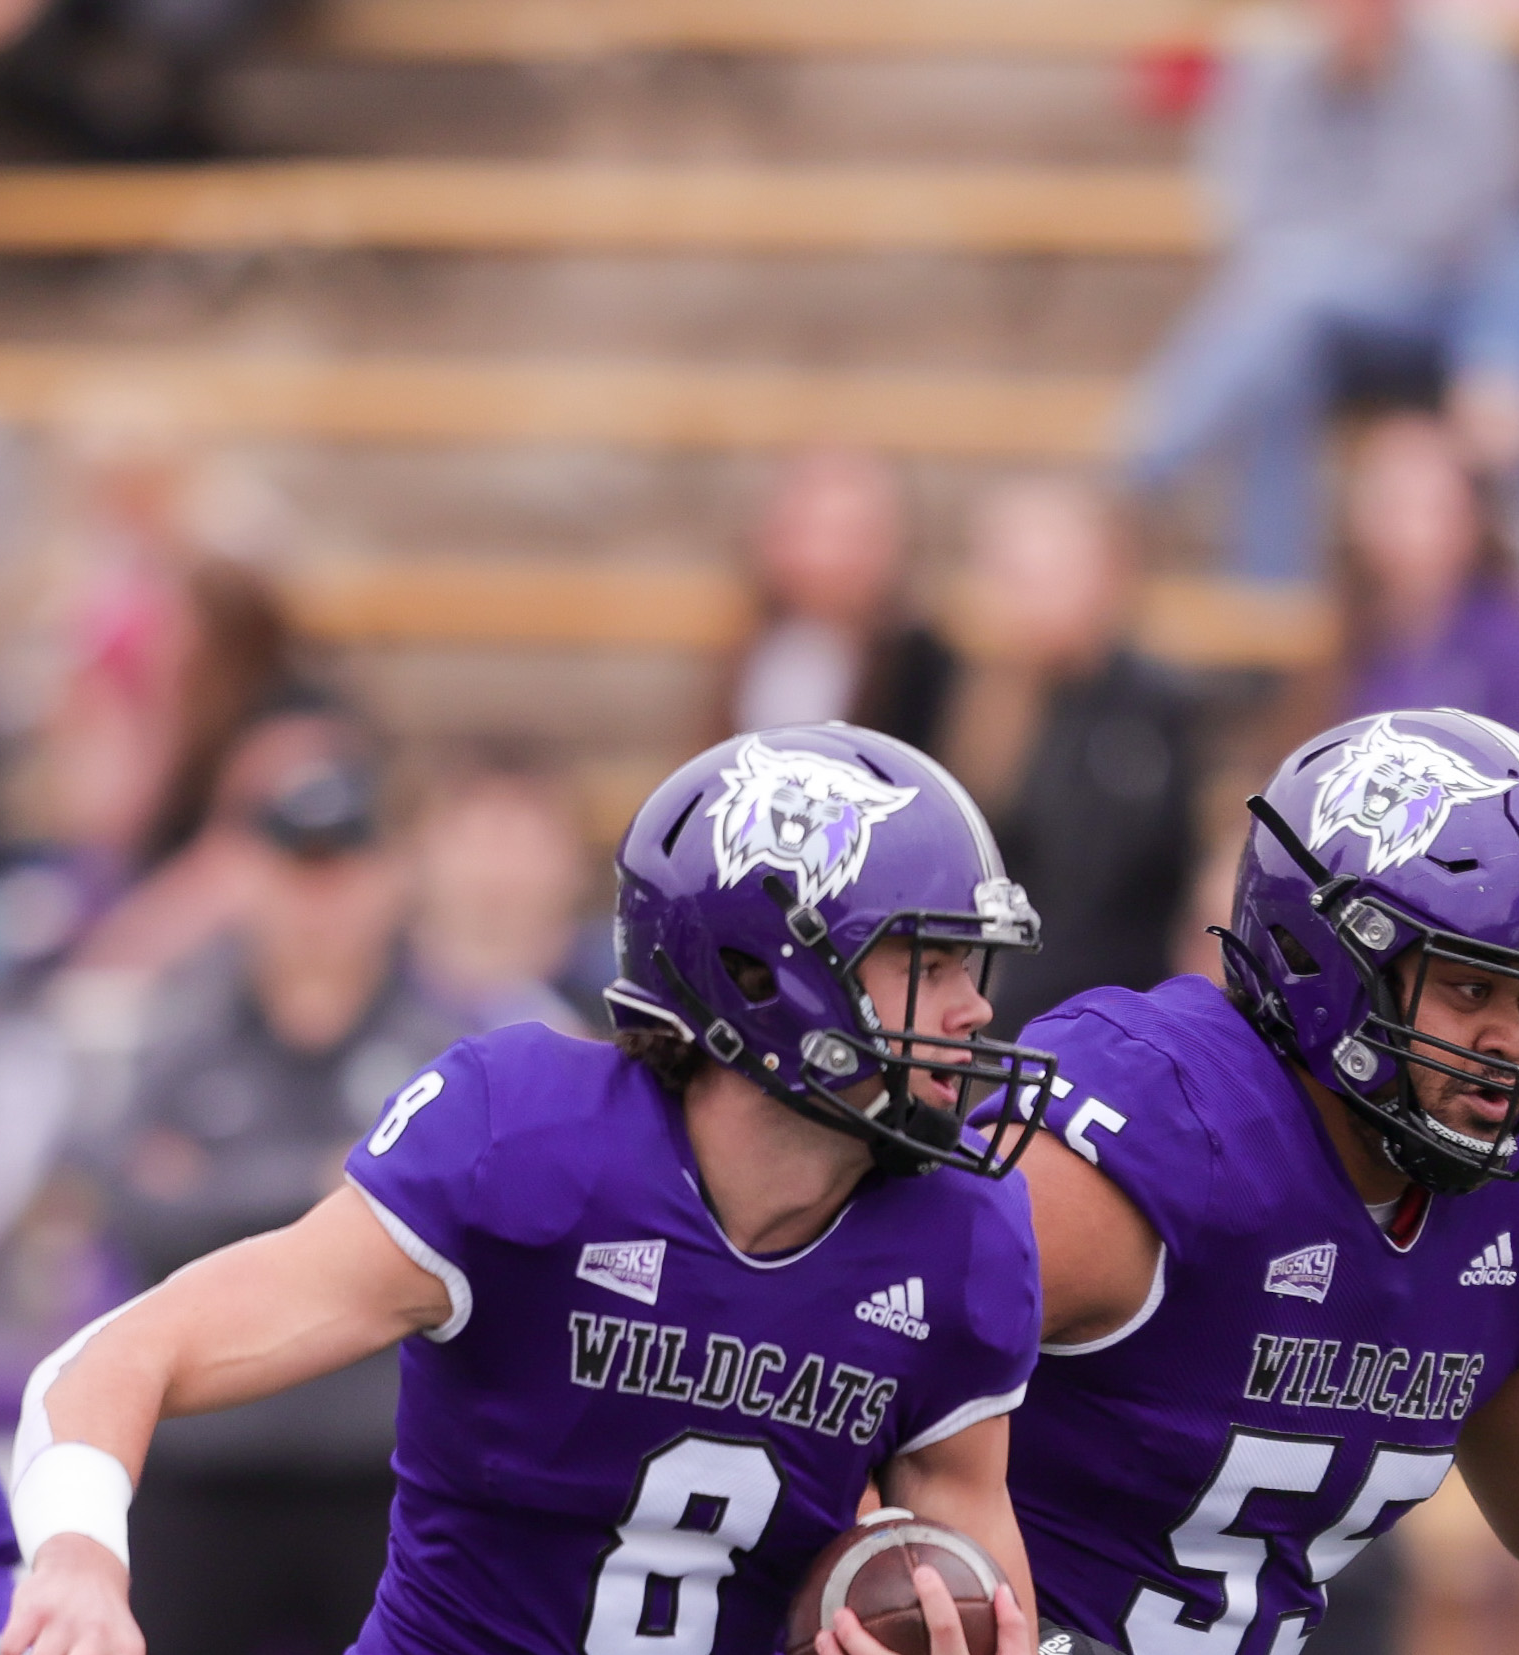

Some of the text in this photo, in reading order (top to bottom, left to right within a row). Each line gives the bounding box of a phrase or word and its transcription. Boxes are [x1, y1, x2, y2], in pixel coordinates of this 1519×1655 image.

[367, 1070, 445, 1157] 8
[1460, 1265, 1517, 1286] adidas
[854, 1300, 930, 1340] adidas
[568, 1310, 898, 1446] WILDCATS
[1243, 1333, 1484, 1421] WILDCATS
